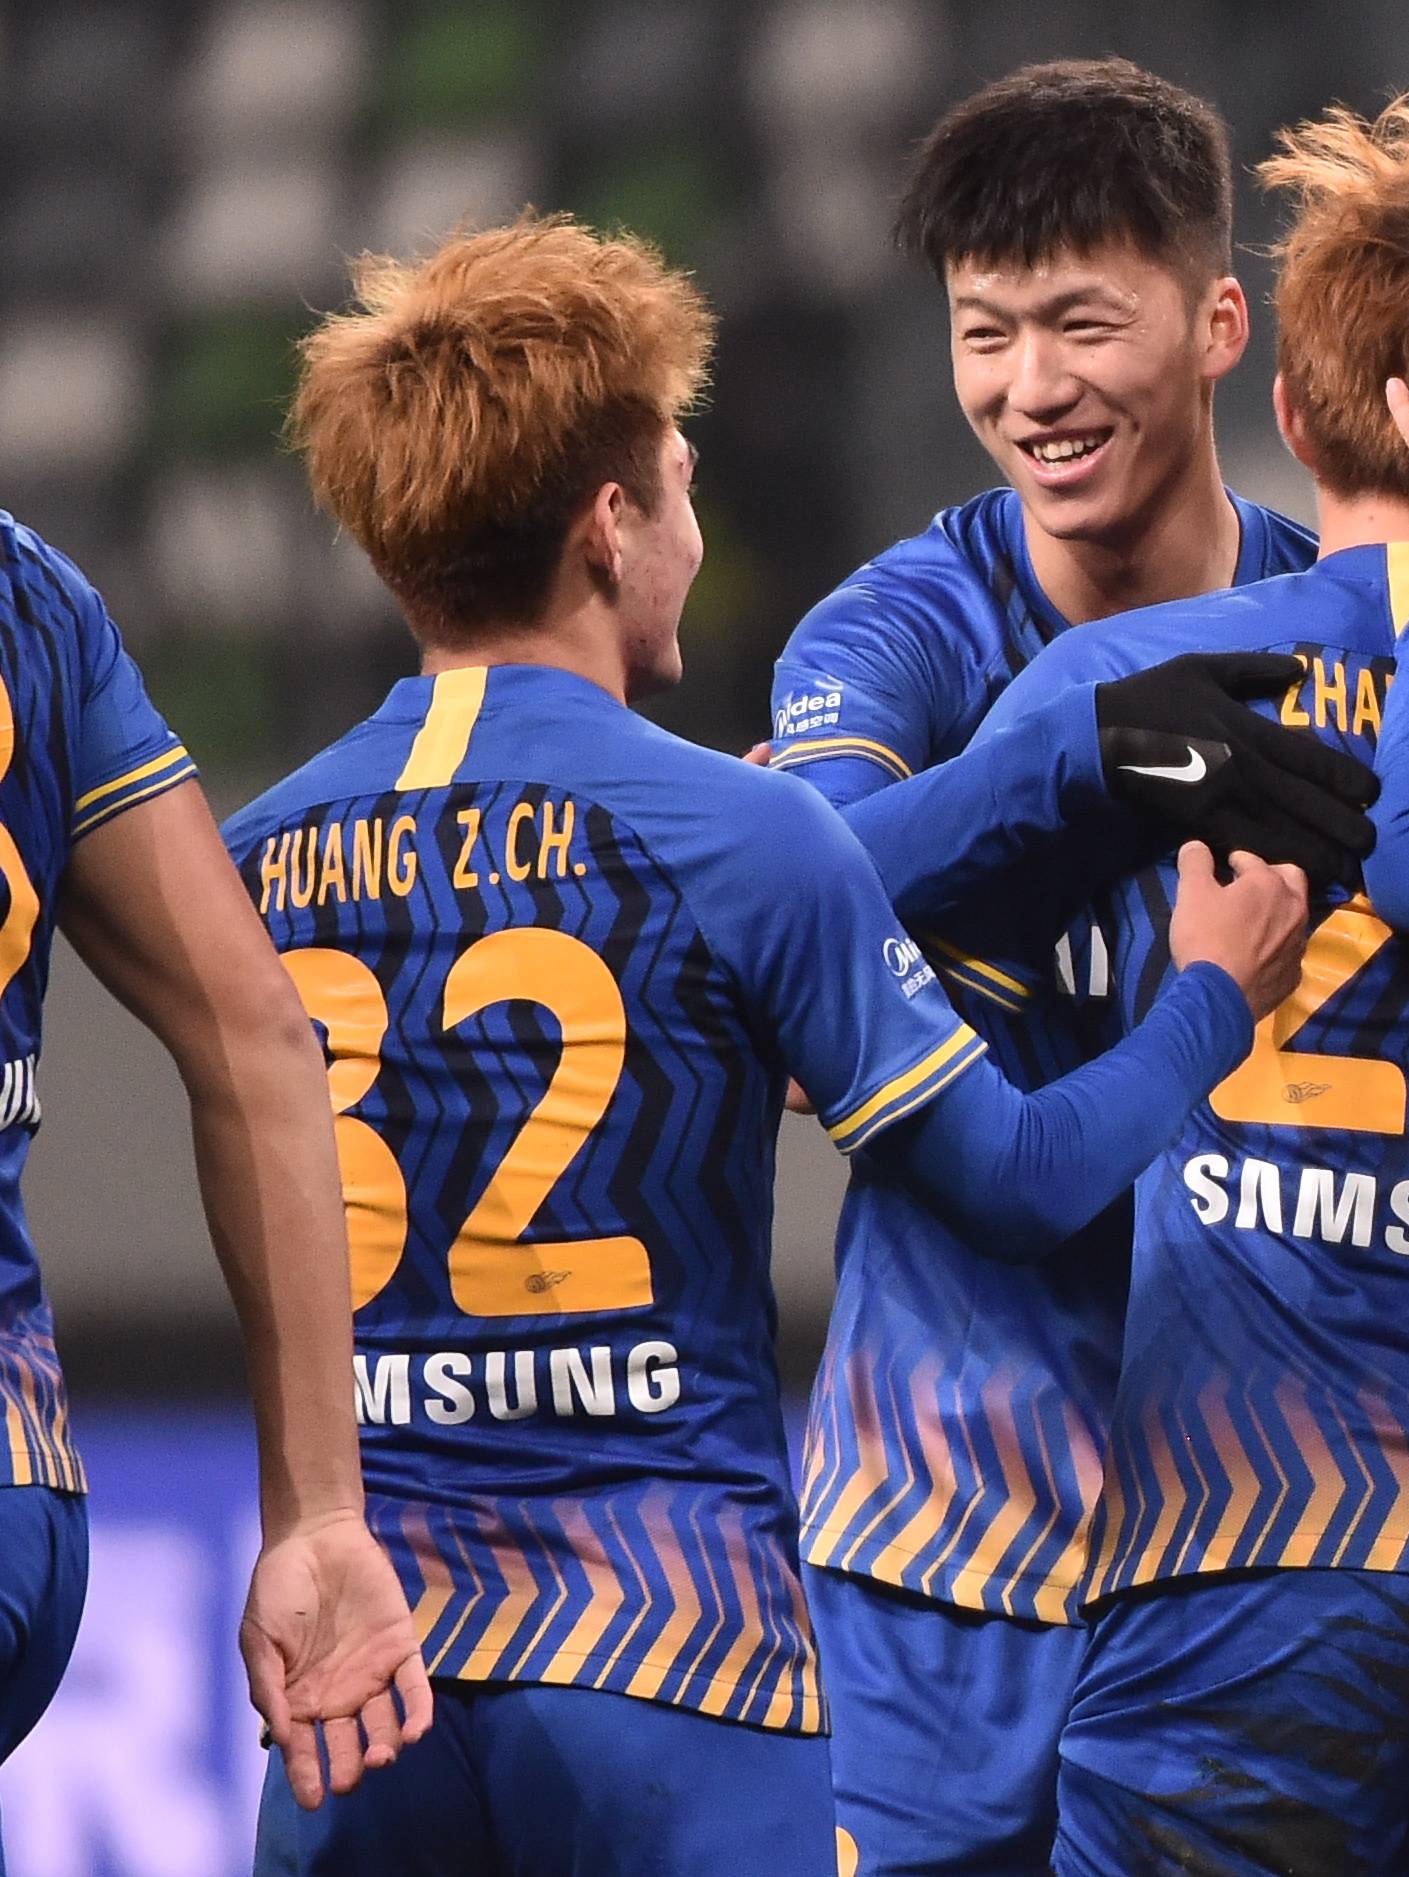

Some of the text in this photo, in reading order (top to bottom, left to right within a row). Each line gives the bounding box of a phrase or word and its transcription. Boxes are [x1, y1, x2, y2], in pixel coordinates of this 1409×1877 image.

[1280, 655, 1394, 737] ZHA
[260, 801, 588, 914] HUANG Z.CH.
[281, 926, 655, 1318] 32
[352, 1340, 682, 1426] MSUNG
